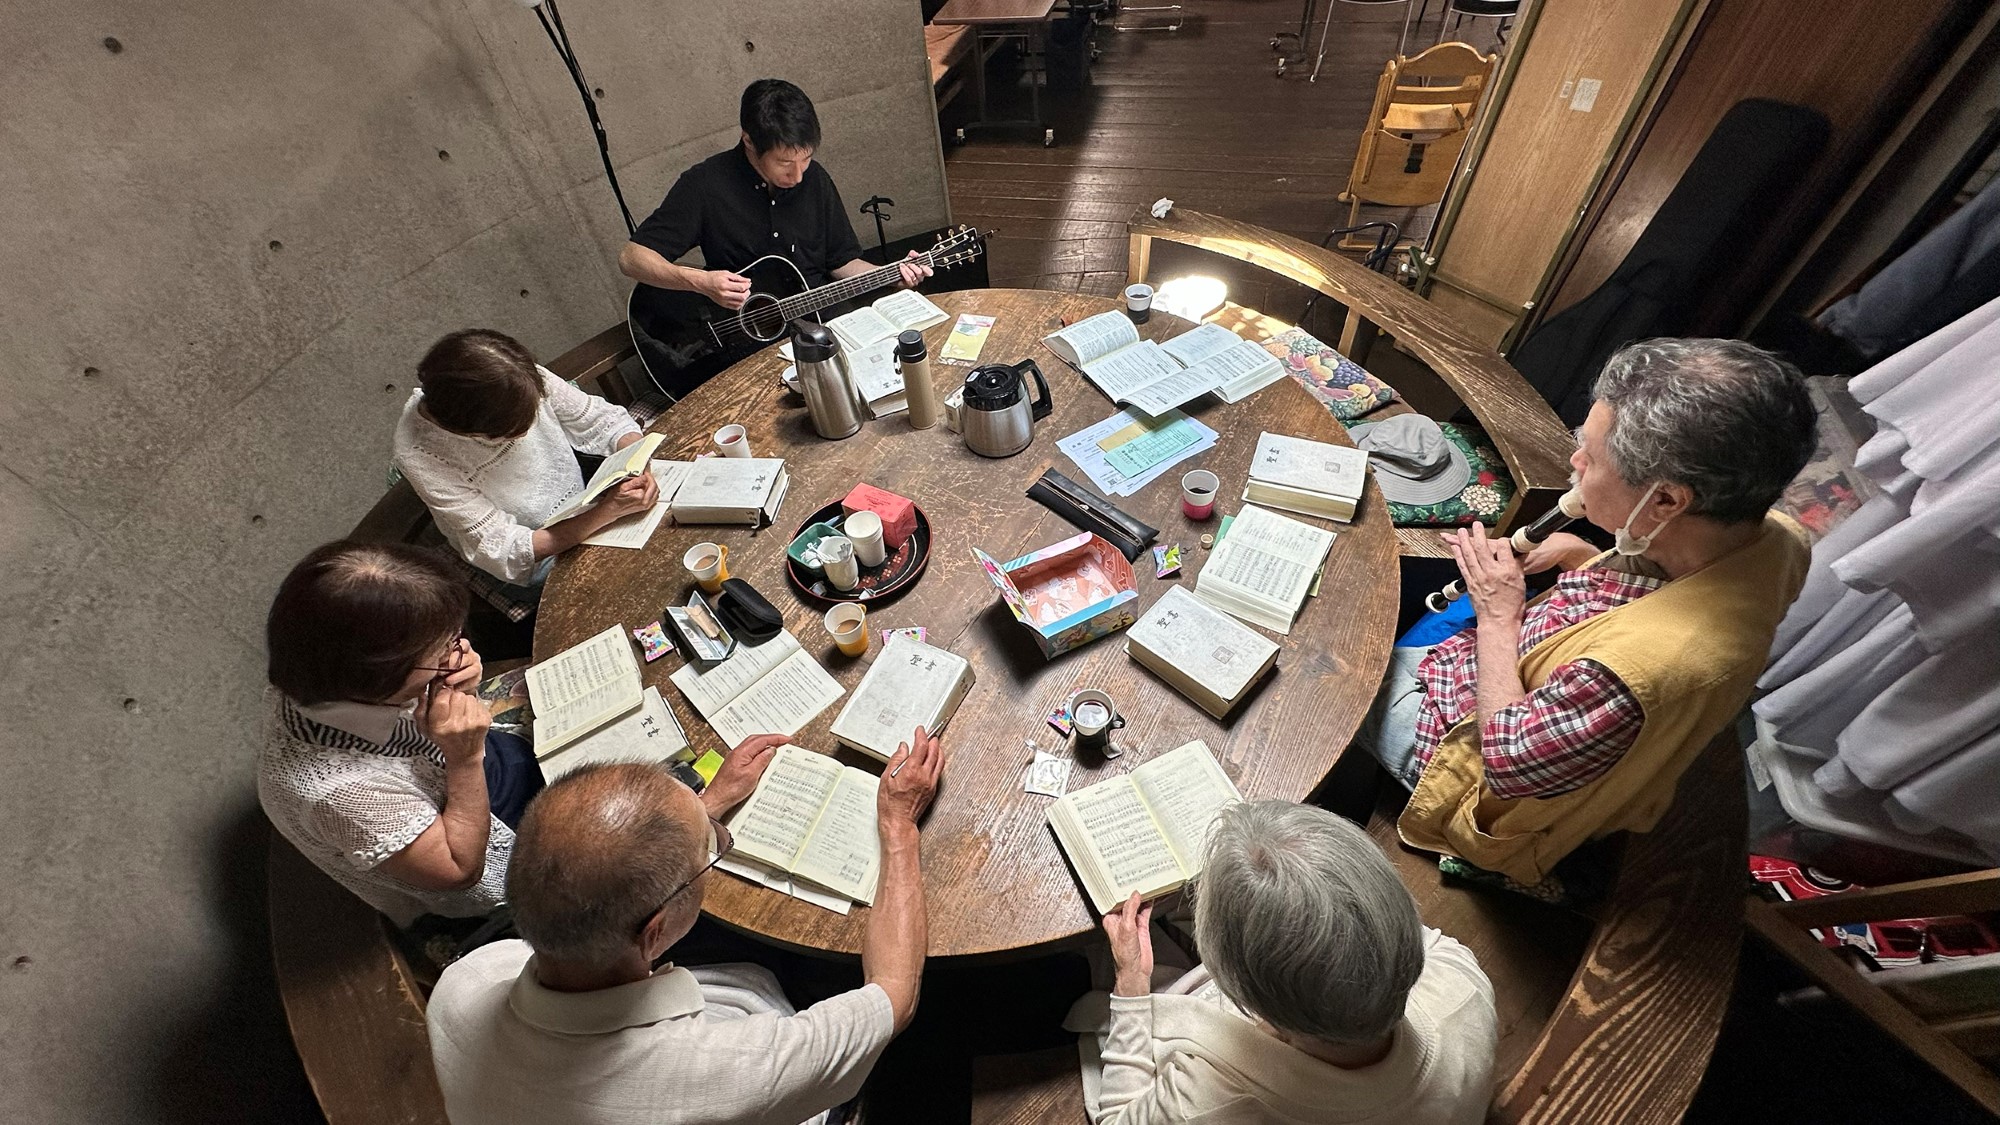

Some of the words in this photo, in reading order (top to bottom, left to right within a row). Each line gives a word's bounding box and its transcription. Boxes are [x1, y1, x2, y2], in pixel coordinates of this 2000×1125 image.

[1156, 610, 1179, 629] 聖書
[909, 654, 938, 672] 聖書
[640, 715, 661, 738] 聖書
